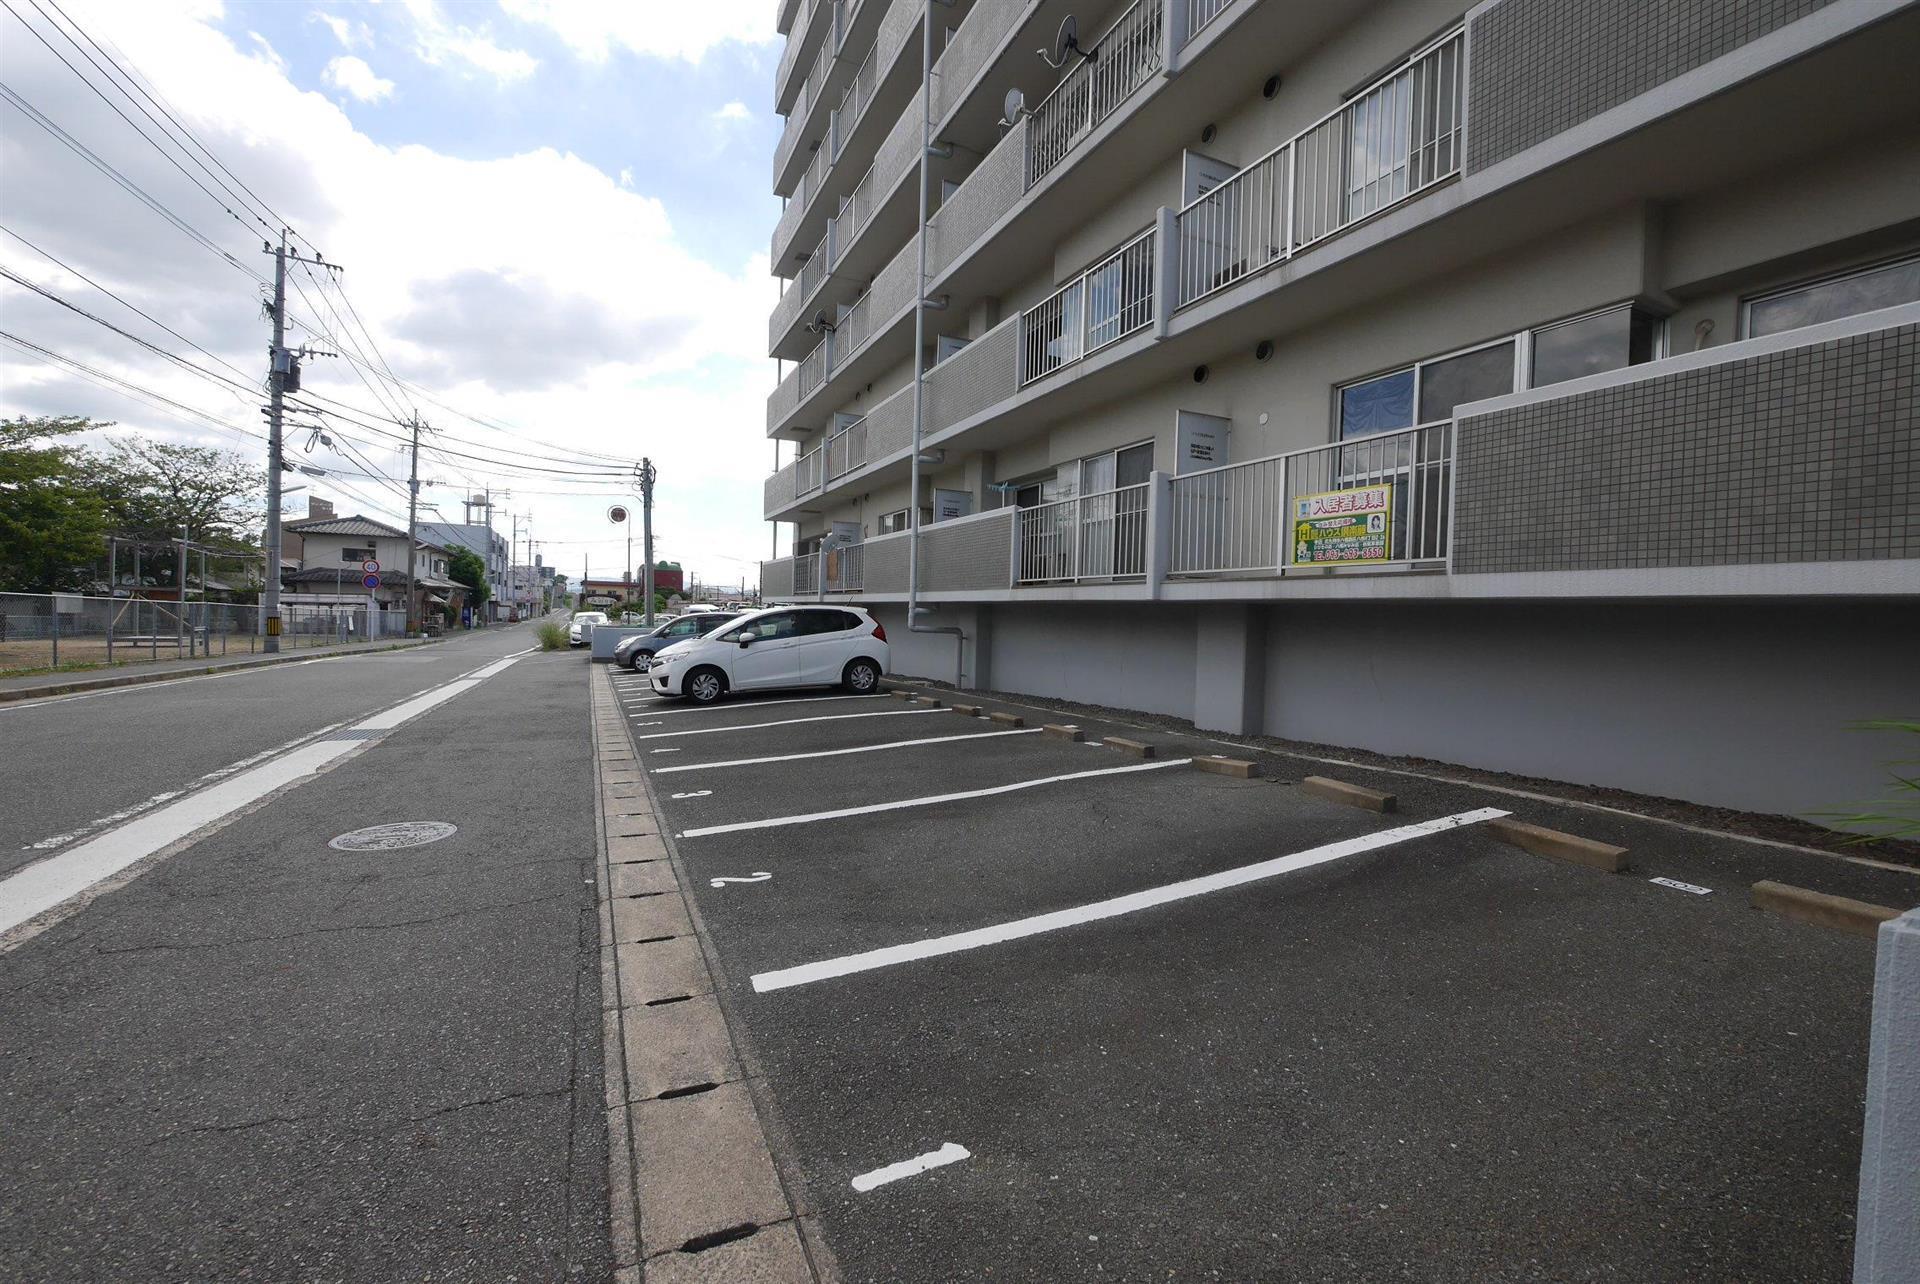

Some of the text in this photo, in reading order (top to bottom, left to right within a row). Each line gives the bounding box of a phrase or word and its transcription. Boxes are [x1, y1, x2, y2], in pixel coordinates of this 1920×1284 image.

[1313, 490, 1384, 515] 入居者募集
[367, 563, 376, 571] 40
[671, 790, 713, 799] 3
[710, 871, 772, 888] 2
[1658, 879, 1704, 893] 502
[851, 1143, 970, 1193] 1
